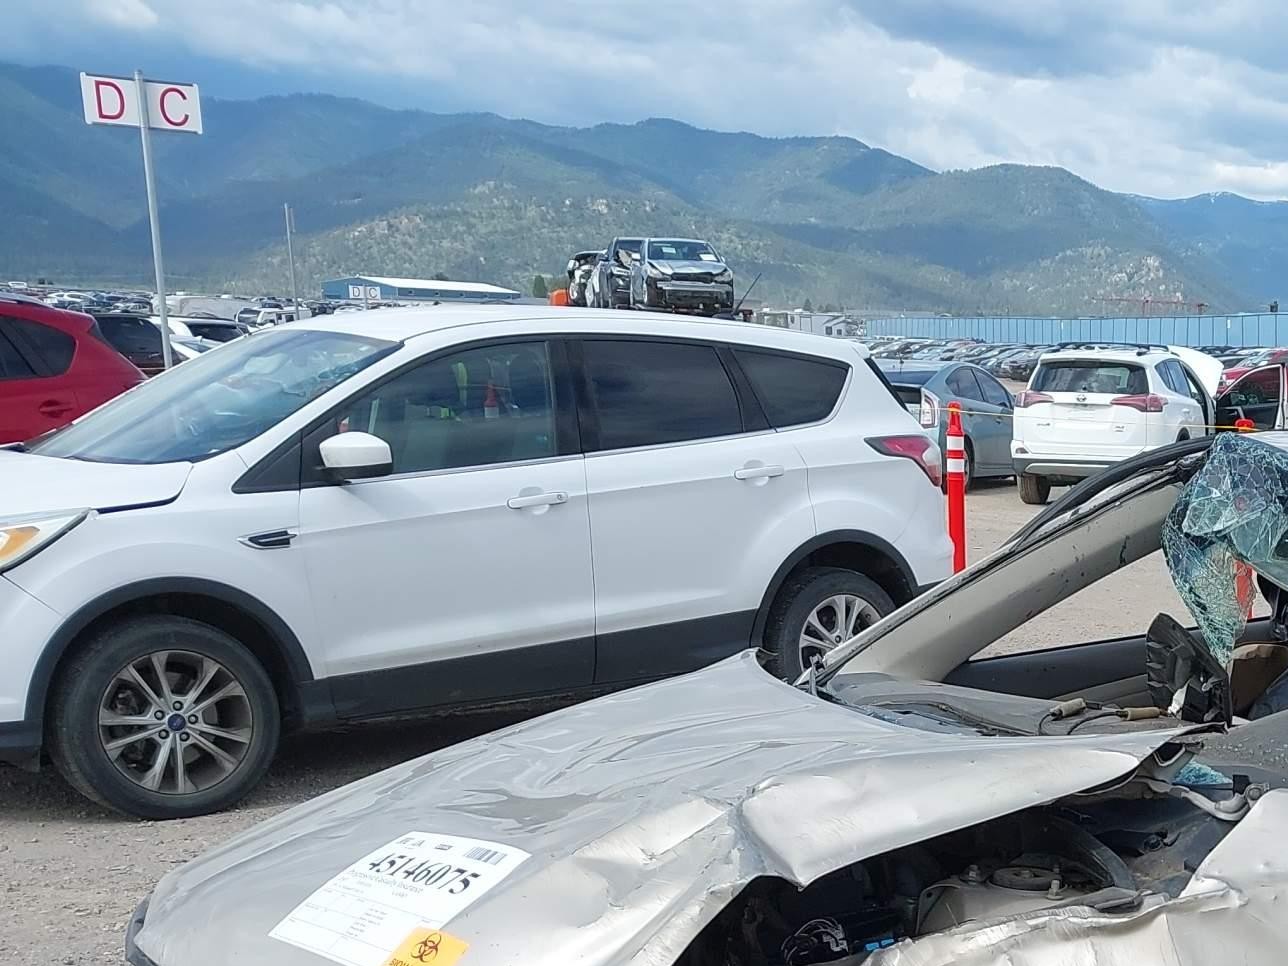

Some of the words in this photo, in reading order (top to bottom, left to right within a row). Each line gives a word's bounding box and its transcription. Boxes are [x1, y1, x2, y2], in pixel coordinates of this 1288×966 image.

[94, 80, 125, 120] D
[160, 87, 190, 127] C
[352, 286, 361, 298] D
[368, 287, 378, 299] C
[368, 853, 481, 895] 45146075
